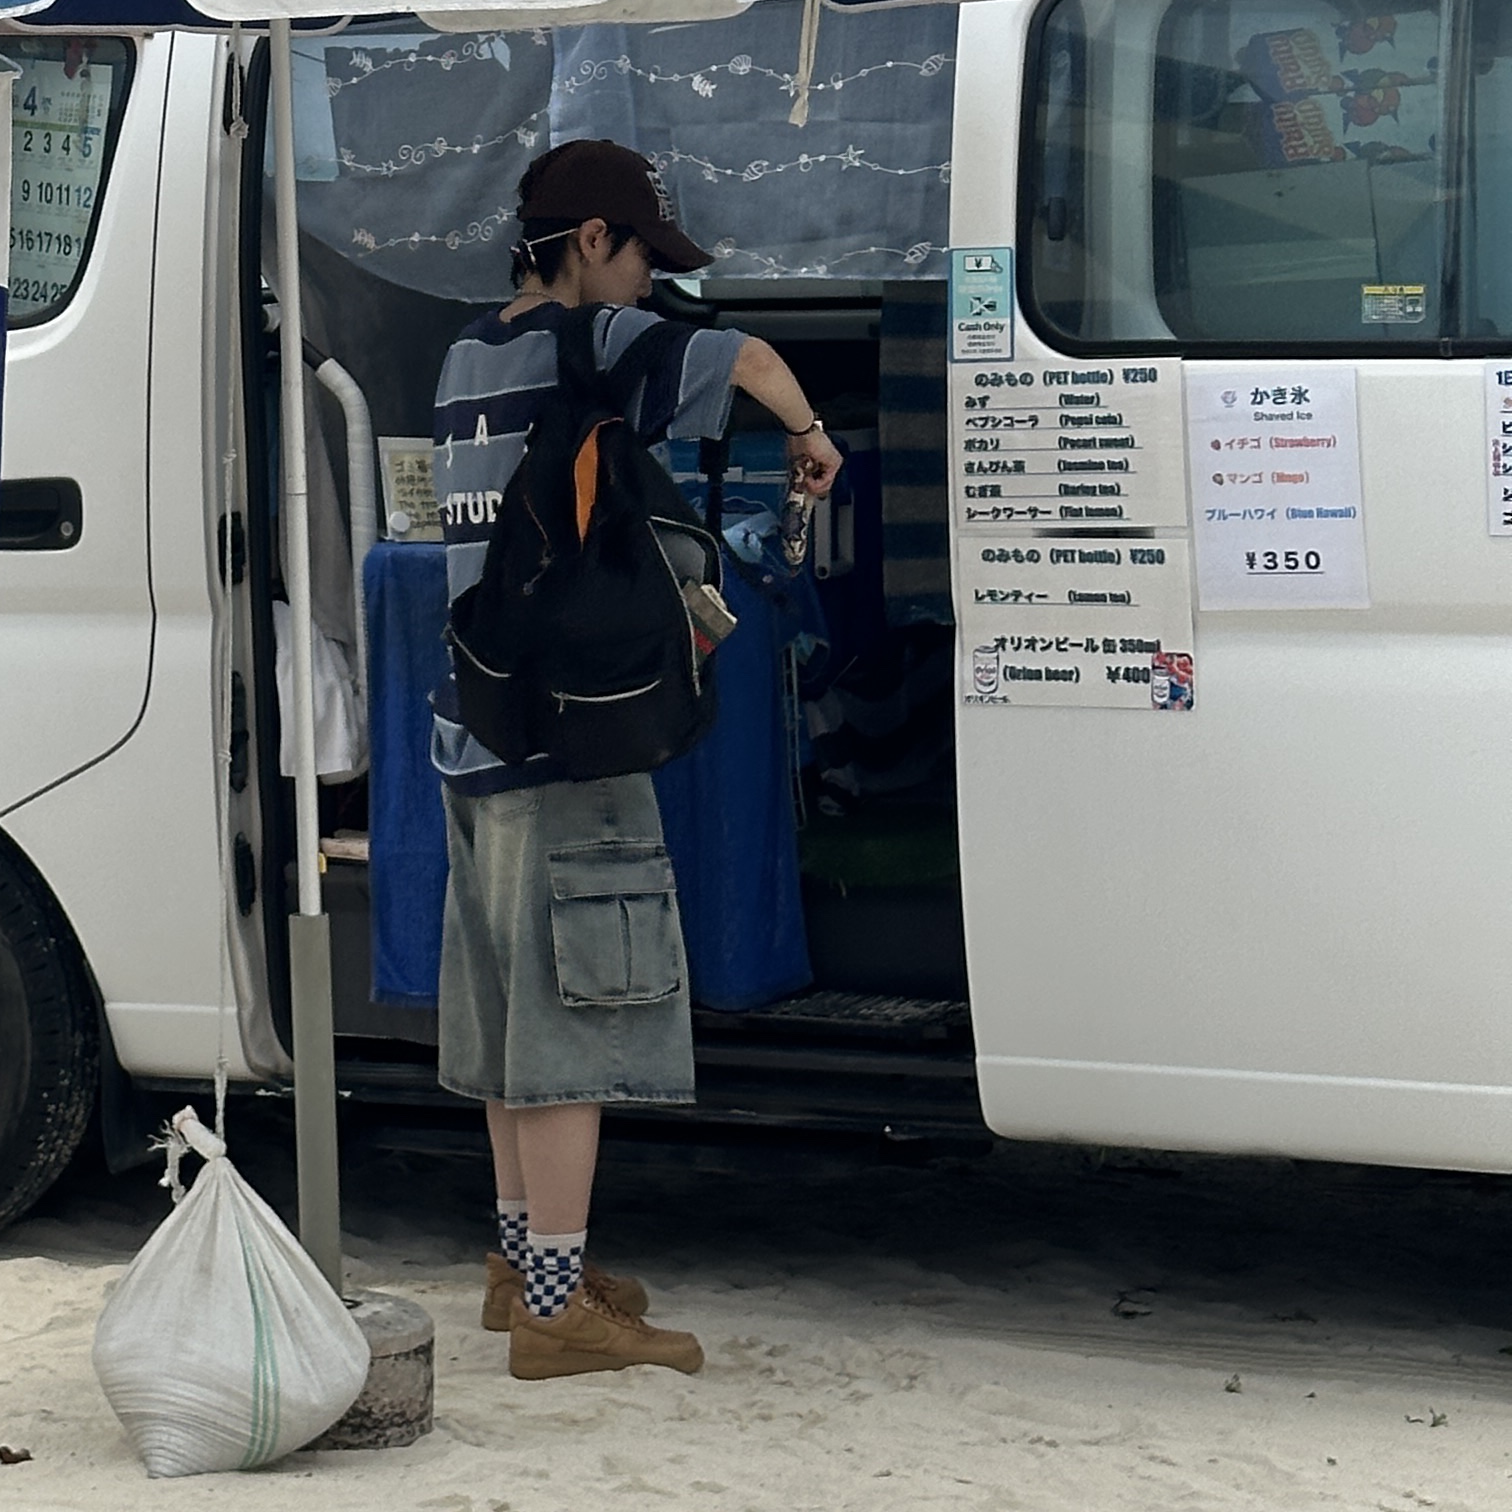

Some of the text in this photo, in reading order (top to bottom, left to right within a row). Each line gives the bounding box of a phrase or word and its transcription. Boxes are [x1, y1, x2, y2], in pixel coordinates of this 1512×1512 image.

[23, 86, 38, 117] 4
[23, 130, 93, 158] 2 3 4 5
[21, 179, 93, 208] 9 10 11 12
[19, 229, 34, 251] 16
[37, 231, 53, 253] 17
[56, 233, 72, 256] 18
[12, 278, 29, 300] 23
[31, 280, 48, 303] 24
[958, 321, 1005, 333] Cash Only
[974, 367, 1158, 387] のみもの (PET bottle) ¥250
[964, 395, 990, 408] みず
[1250, 386, 1311, 405] かき氷
[965, 415, 1039, 429] ペプシコーラ
[1253, 411, 1313, 421] Shaved Ice
[1225, 437, 1261, 449] イチゴ
[1227, 473, 1263, 484] マンゴ
[966, 506, 1052, 519] シークワーサー
[1205, 508, 1277, 521] ブルーハワイ
[981, 548, 1165, 565] のみもの (PET bottle) ¥250
[1245, 551, 1321, 570] ¥350
[974, 589, 1049, 602] レモンティー
[994, 637, 1099, 653] オリオンビール
